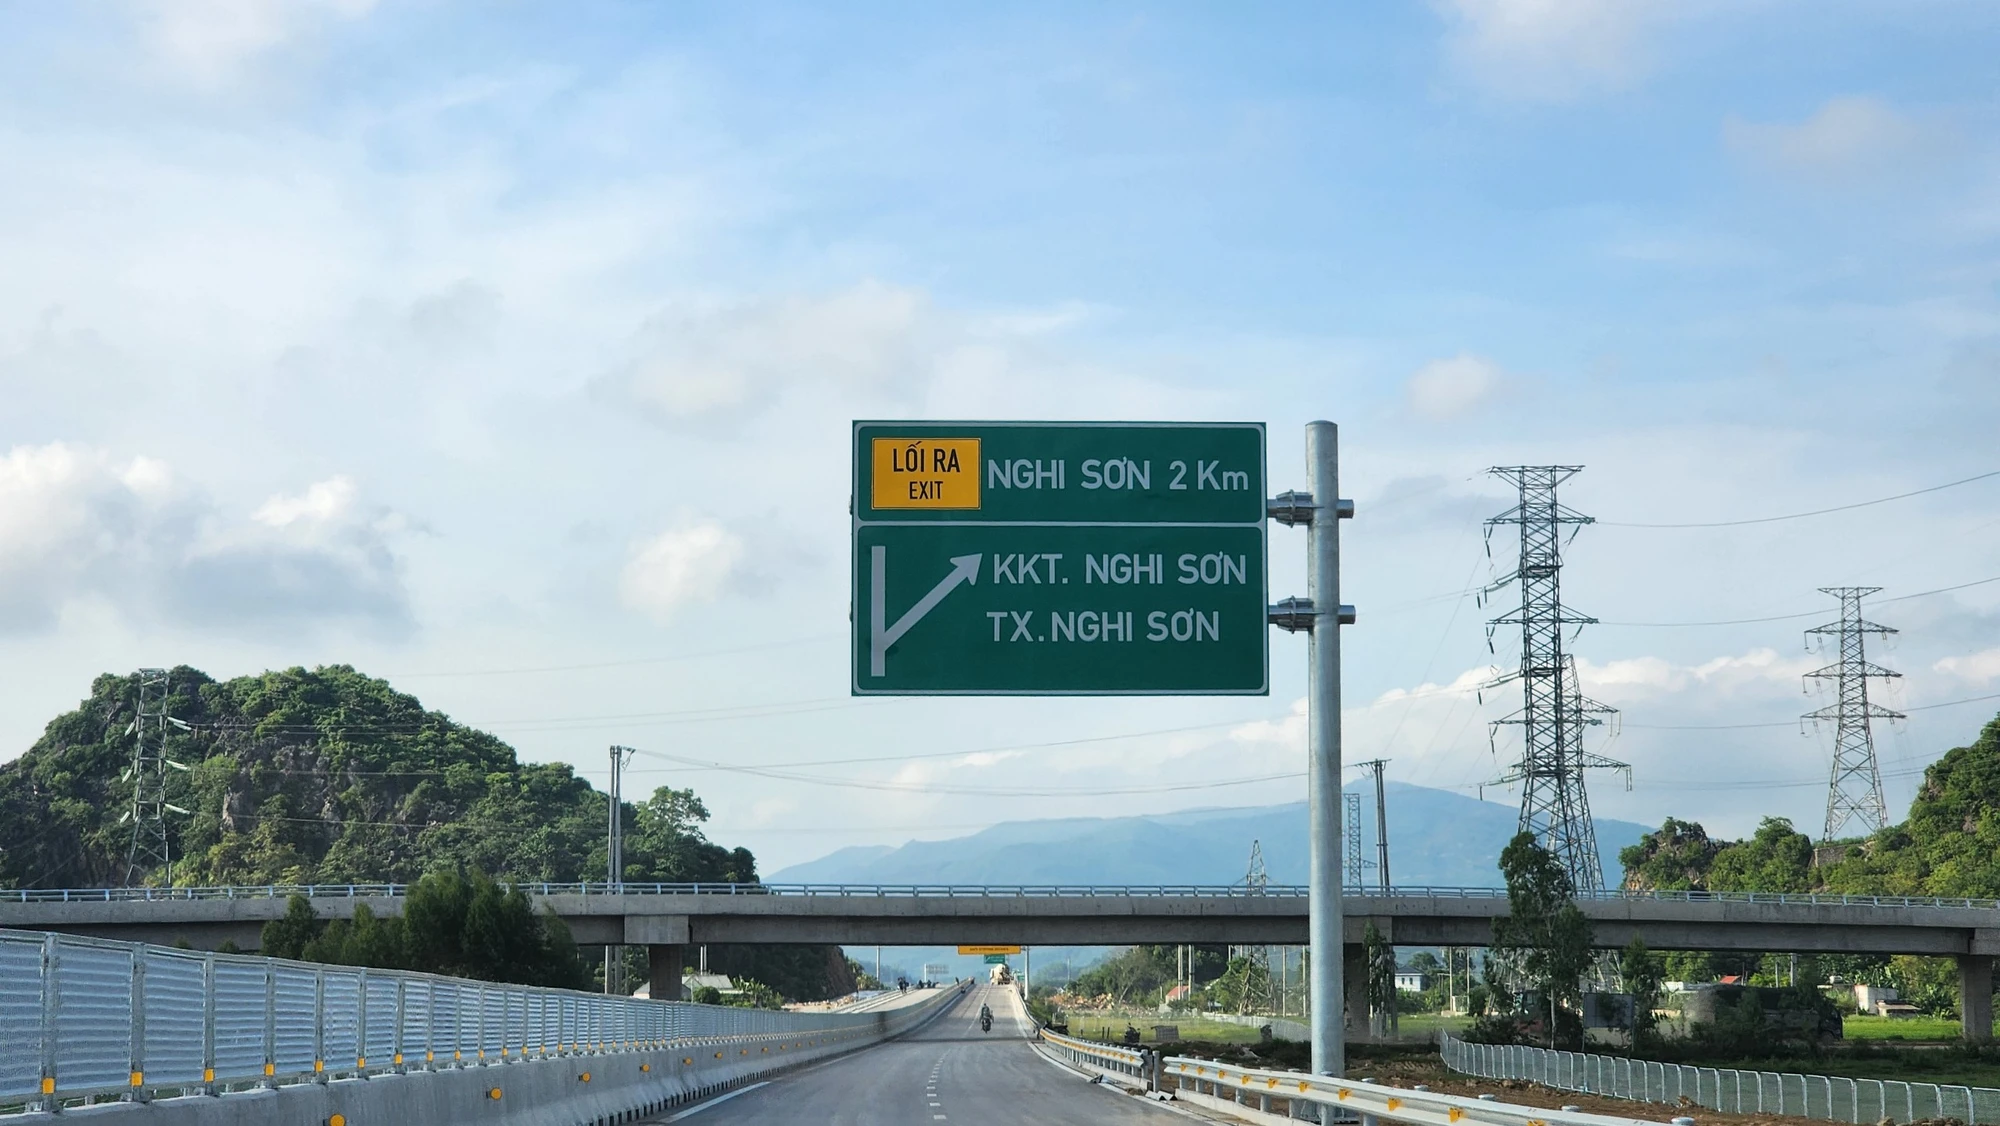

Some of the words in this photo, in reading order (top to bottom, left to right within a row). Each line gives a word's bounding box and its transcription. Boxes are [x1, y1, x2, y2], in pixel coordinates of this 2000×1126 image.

[893, 441, 925, 473] LỐI
[934, 448, 961, 473] RA
[988, 459, 1065, 489] NGHI
[1081, 456, 1150, 490] SƠN
[1170, 460, 1187, 490] 2
[1198, 460, 1249, 491] Km
[909, 480, 944, 500] EXIT
[994, 553, 1068, 584] KKT.
[1085, 553, 1163, 584] NGHI
[1177, 551, 1246, 585] SƠN
[1146, 607, 1219, 642] SƠN
